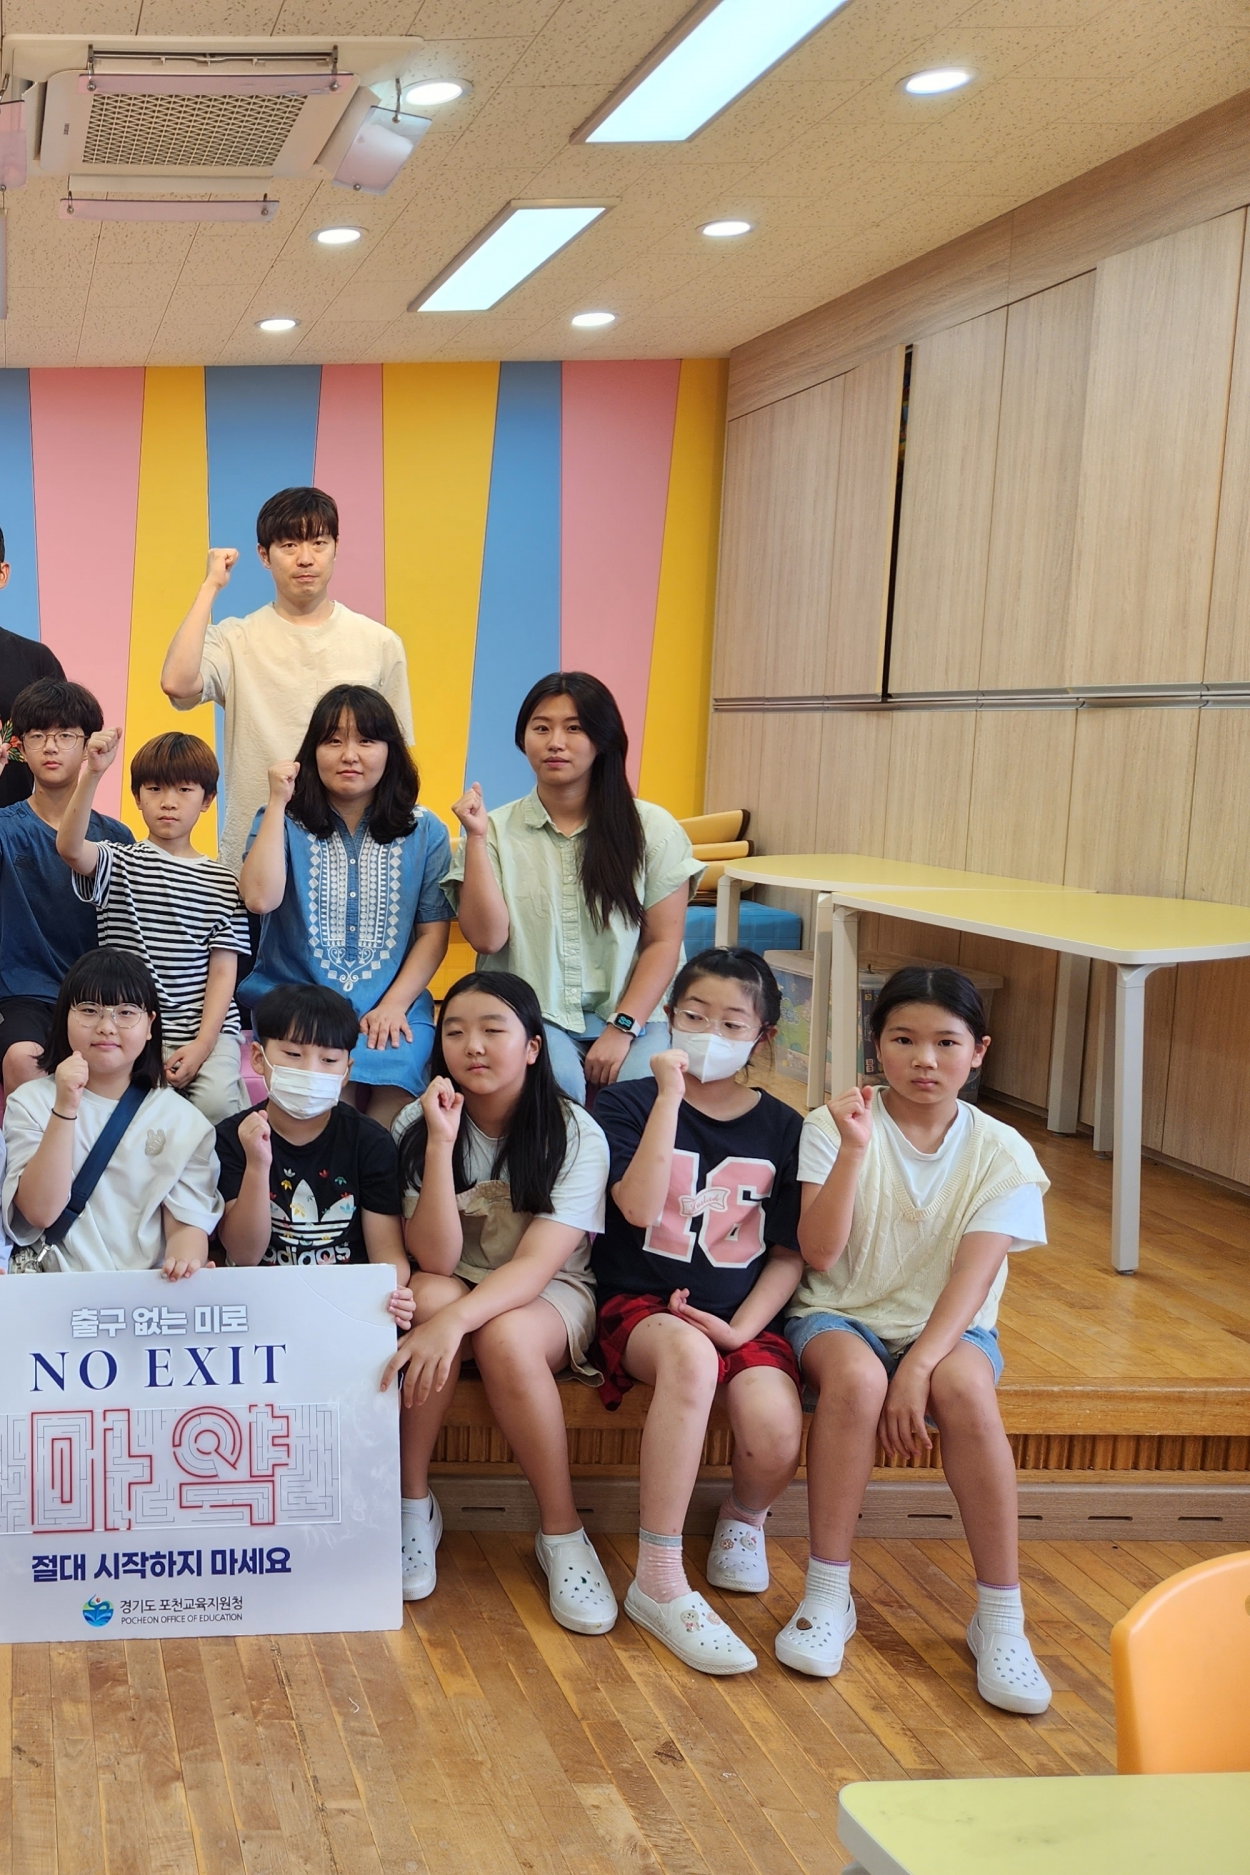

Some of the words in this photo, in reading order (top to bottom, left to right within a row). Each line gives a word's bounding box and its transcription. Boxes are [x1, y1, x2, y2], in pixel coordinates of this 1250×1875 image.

[642, 1148, 777, 1269] 16
[71, 1306, 127, 1339] 출구
[132, 1305, 188, 1337] 없는
[194, 1304, 249, 1335] 미로
[29, 1349, 118, 1392] NO
[144, 1344, 288, 1388] EXIT
[30, 1403, 291, 1534] 마약
[31, 1552, 86, 1583] 절대
[93, 1549, 203, 1581] 시작하지
[210, 1547, 292, 1576] 마세요
[120, 1599, 157, 1614] 경기도
[158, 1595, 243, 1613] 포천교육지원청
[121, 1616, 159, 1625] POCHEON
[161, 1615, 186, 1624] OFFICE
[187, 1614, 198, 1623] OF
[199, 1613, 243, 1622] EDUCATION
